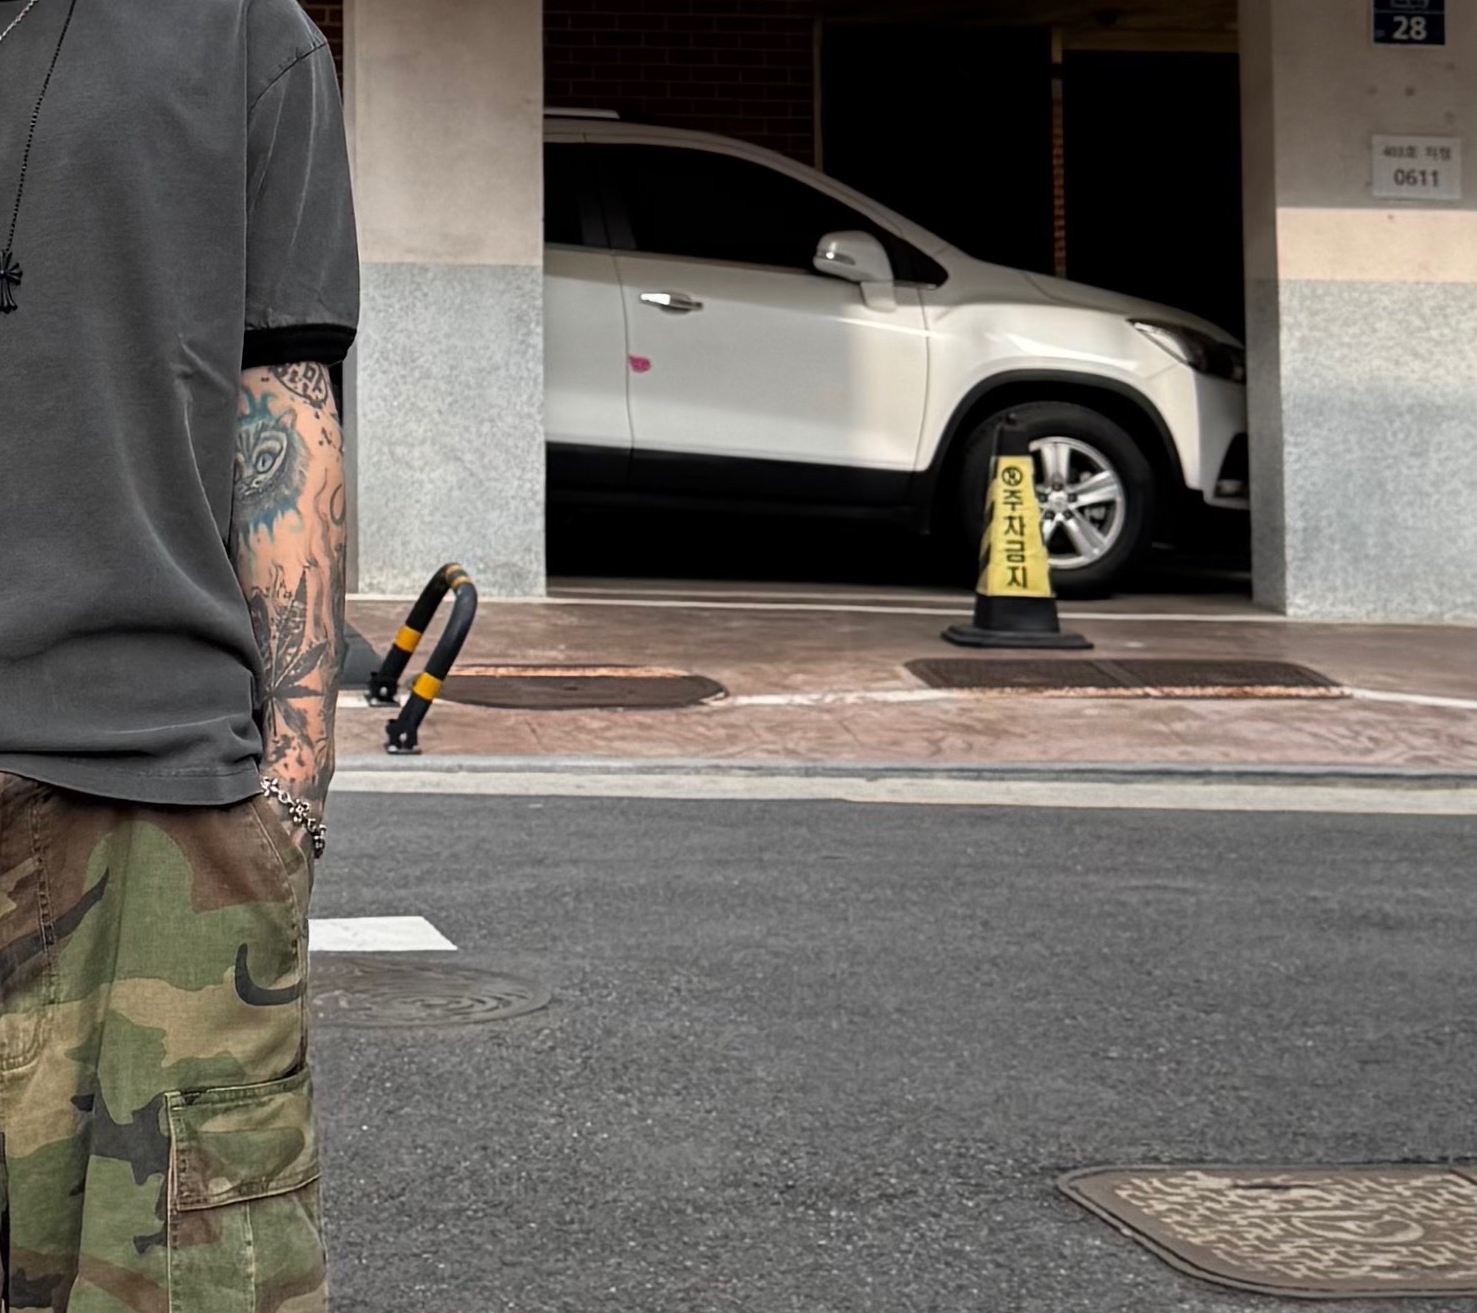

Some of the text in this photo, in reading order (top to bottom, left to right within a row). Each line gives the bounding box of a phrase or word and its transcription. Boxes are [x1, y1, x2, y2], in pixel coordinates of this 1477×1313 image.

[1392, 16, 1427, 40] 28
[1393, 168, 1438, 188] 0611
[1002, 489, 1028, 588] 주차금지
